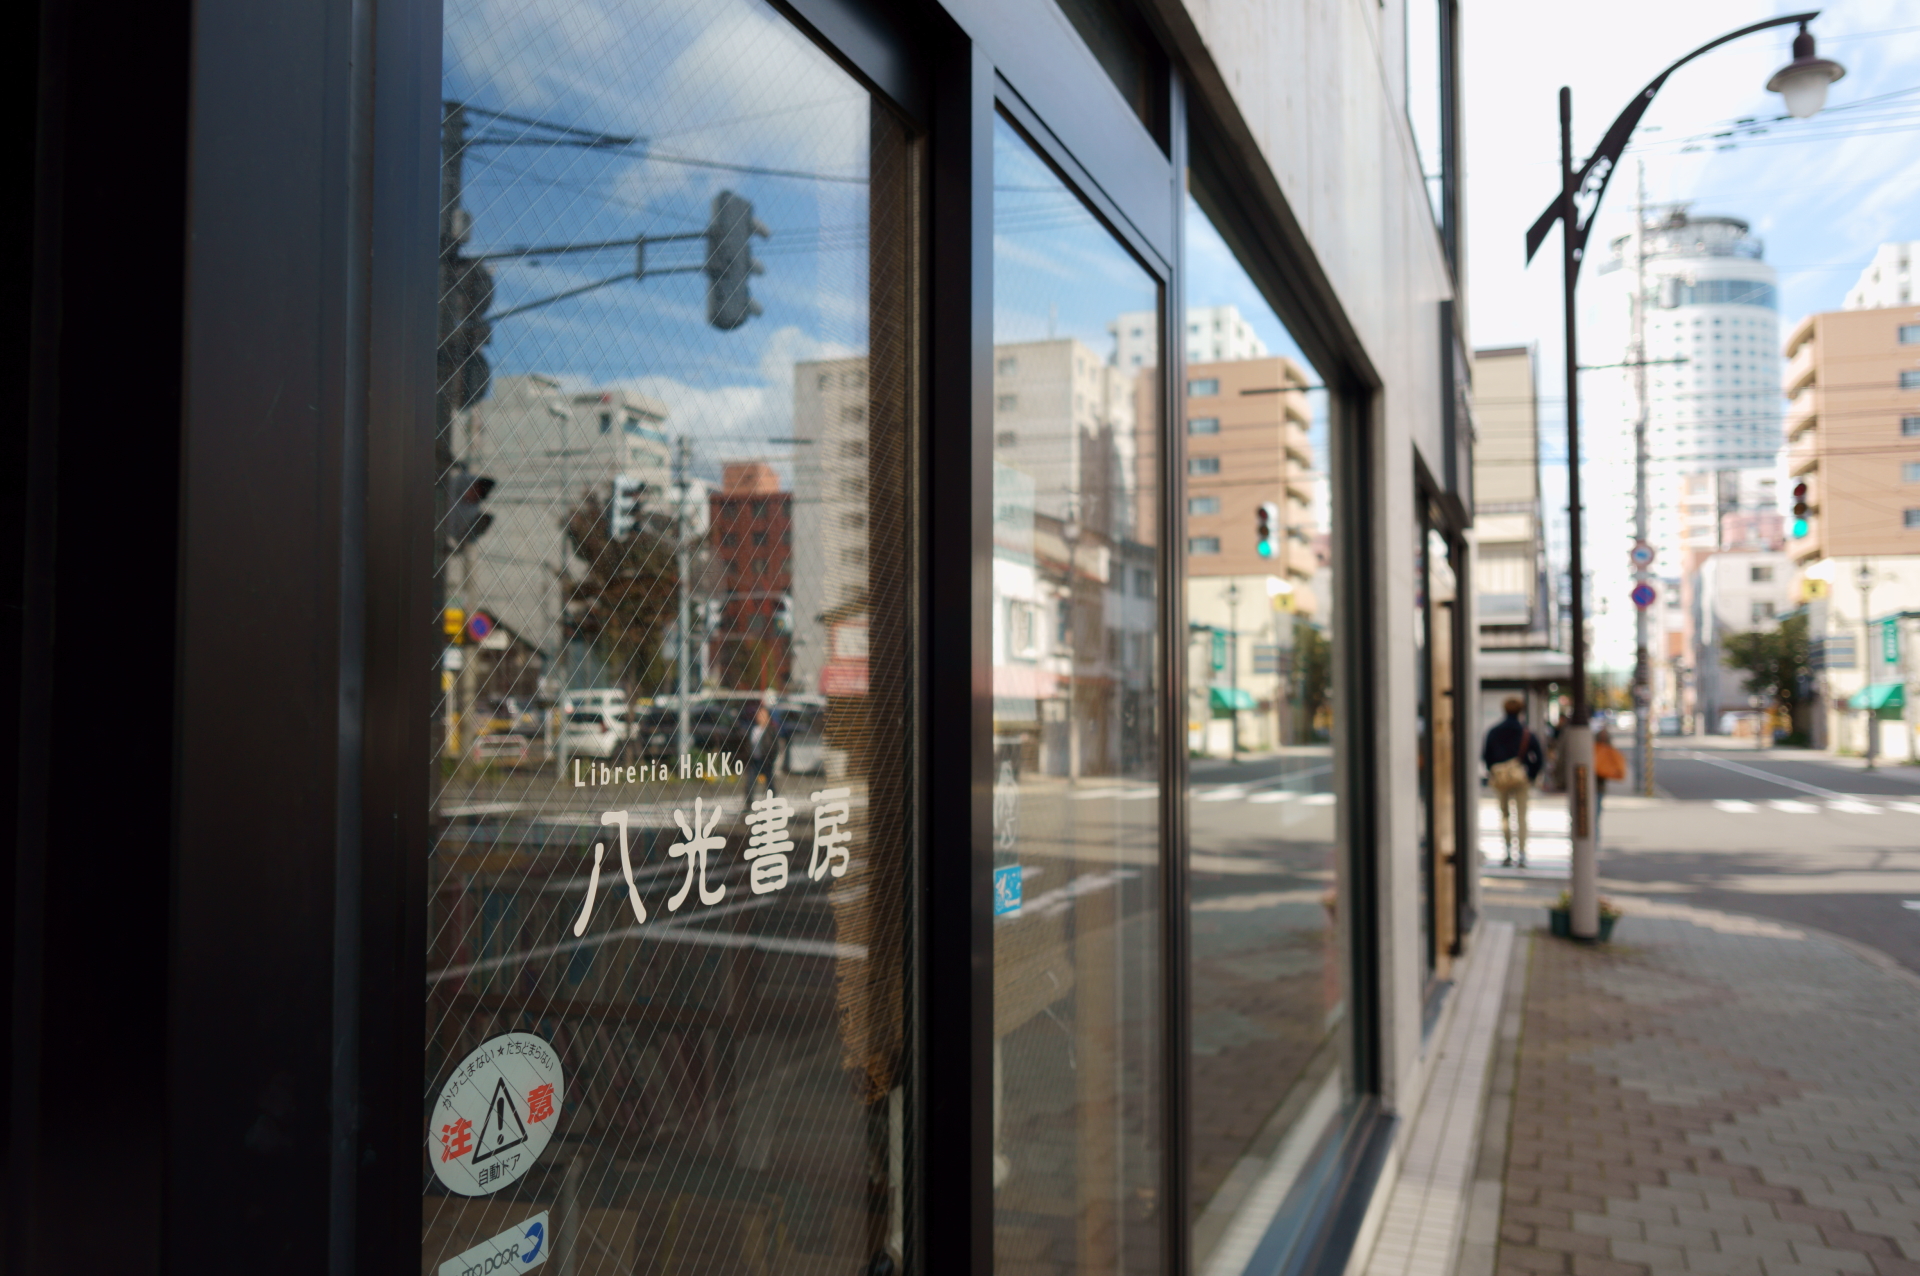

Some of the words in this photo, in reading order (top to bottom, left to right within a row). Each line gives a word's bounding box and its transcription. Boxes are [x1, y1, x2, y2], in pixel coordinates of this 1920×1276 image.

[574, 758, 668, 787] Libreria
[680, 751, 744, 780] HaKKo
[573, 787, 852, 937] 八光書房
[478, 1153, 521, 1188] 自動ドア
[484, 1243, 520, 1275] DOOR
